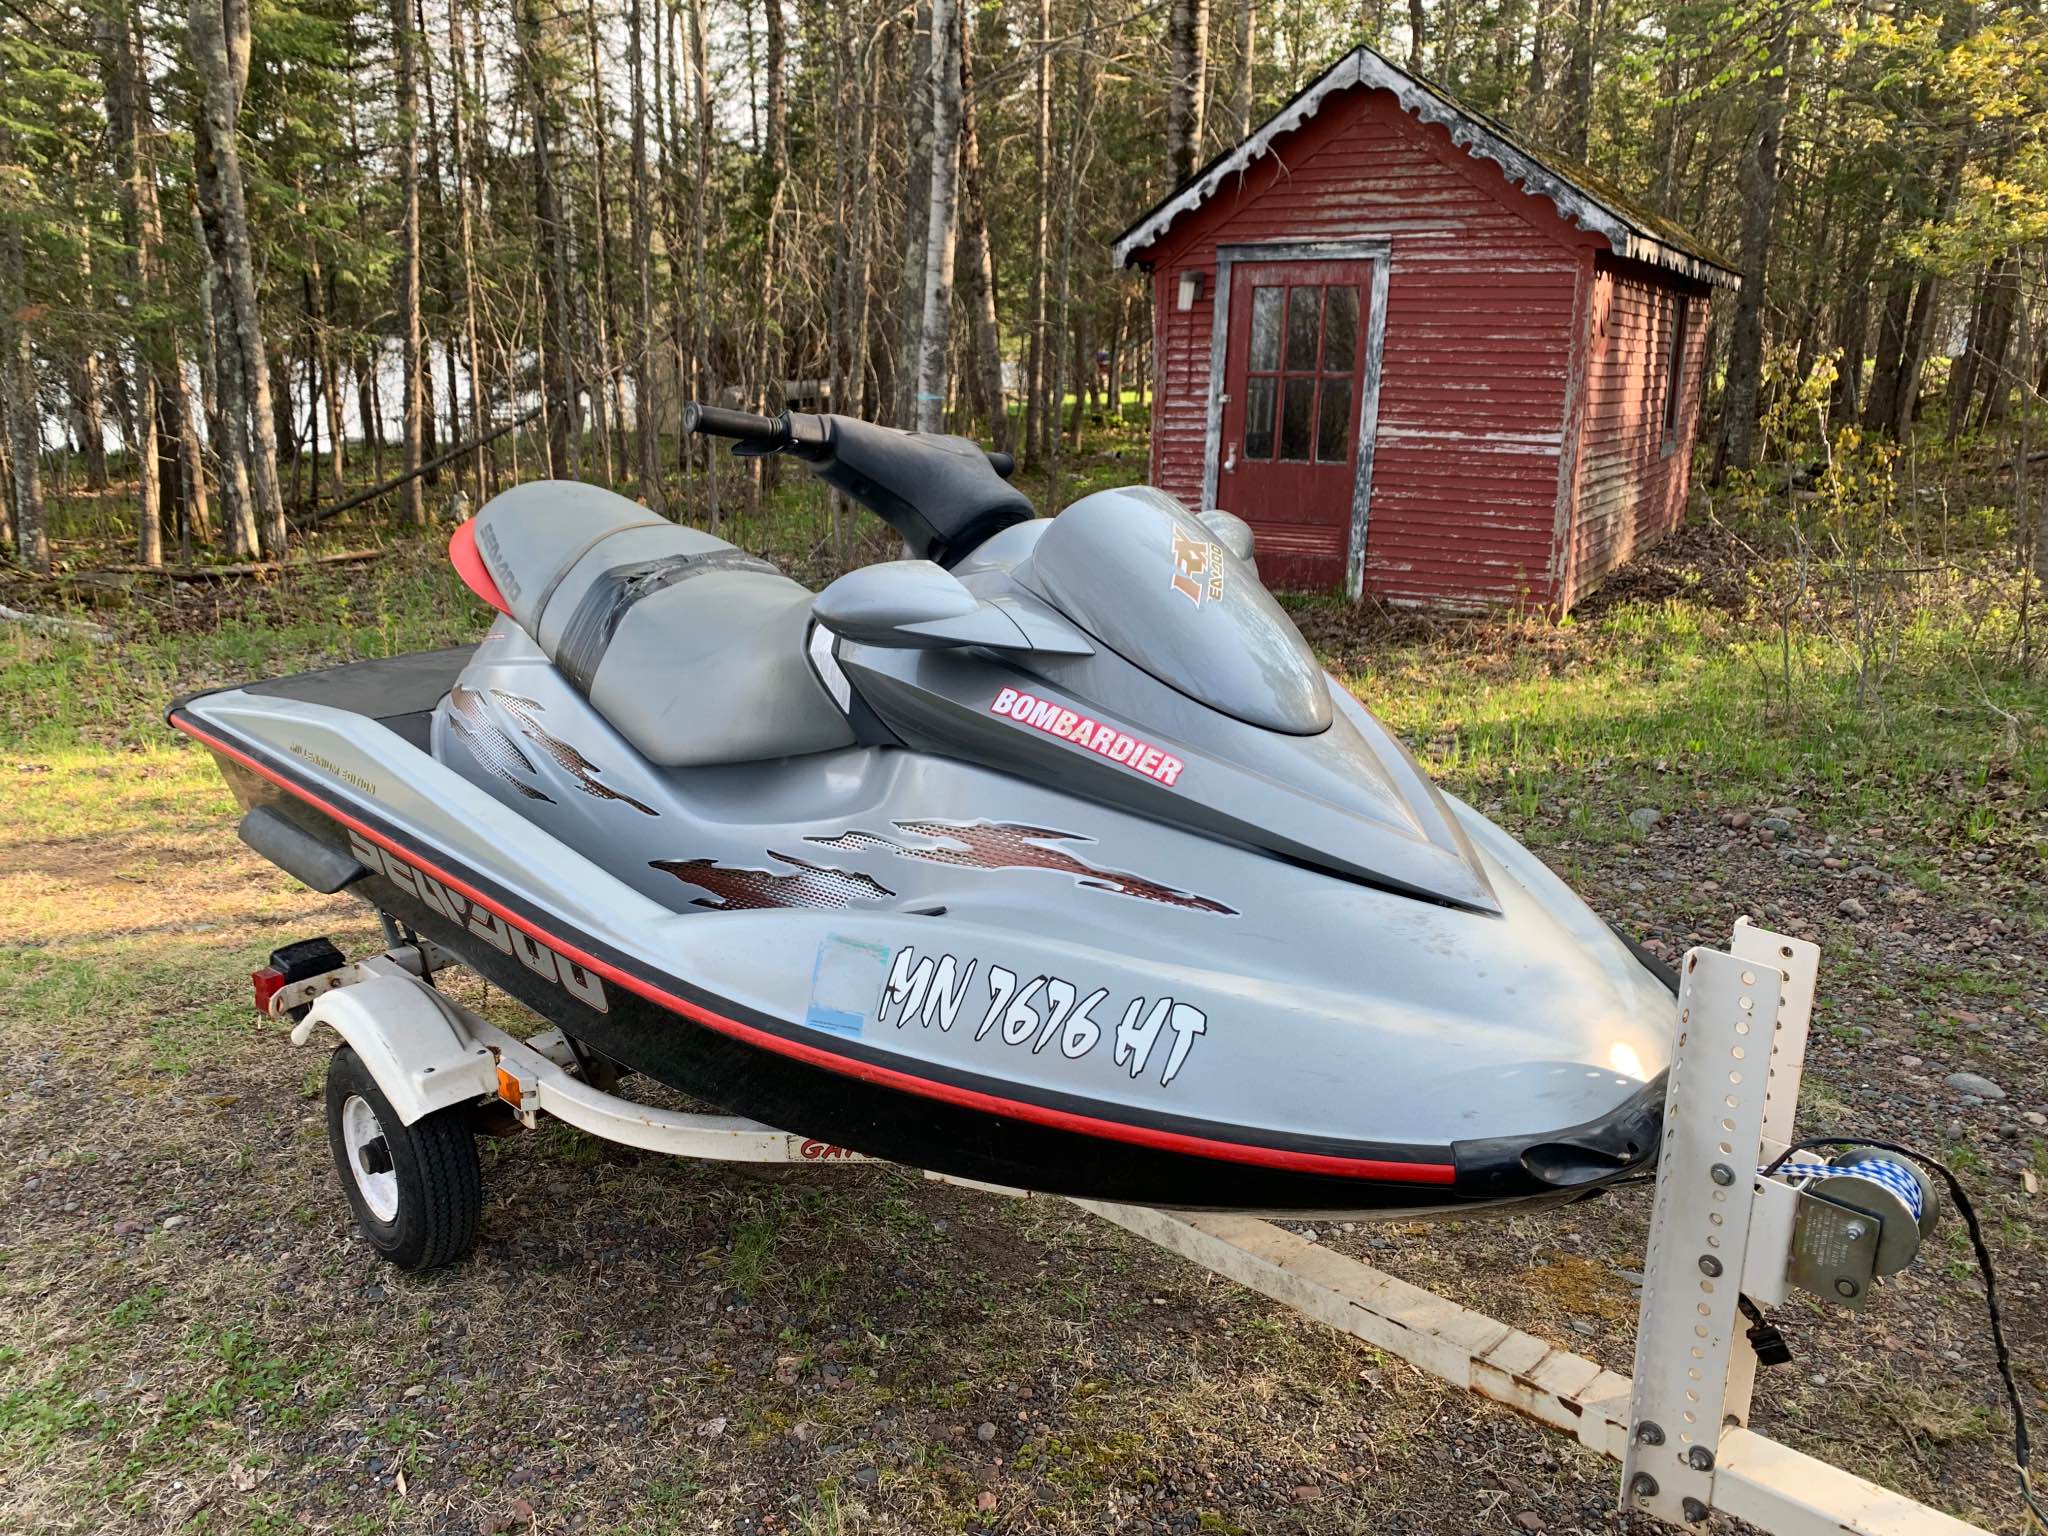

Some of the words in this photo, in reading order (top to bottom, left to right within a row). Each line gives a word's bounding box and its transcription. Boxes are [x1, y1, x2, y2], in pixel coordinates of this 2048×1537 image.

[991, 688, 1184, 786] BOMBARDIER
[879, 946, 977, 1031] MN
[975, 965, 1109, 1059] 7676
[1113, 996, 1208, 1088] HT
